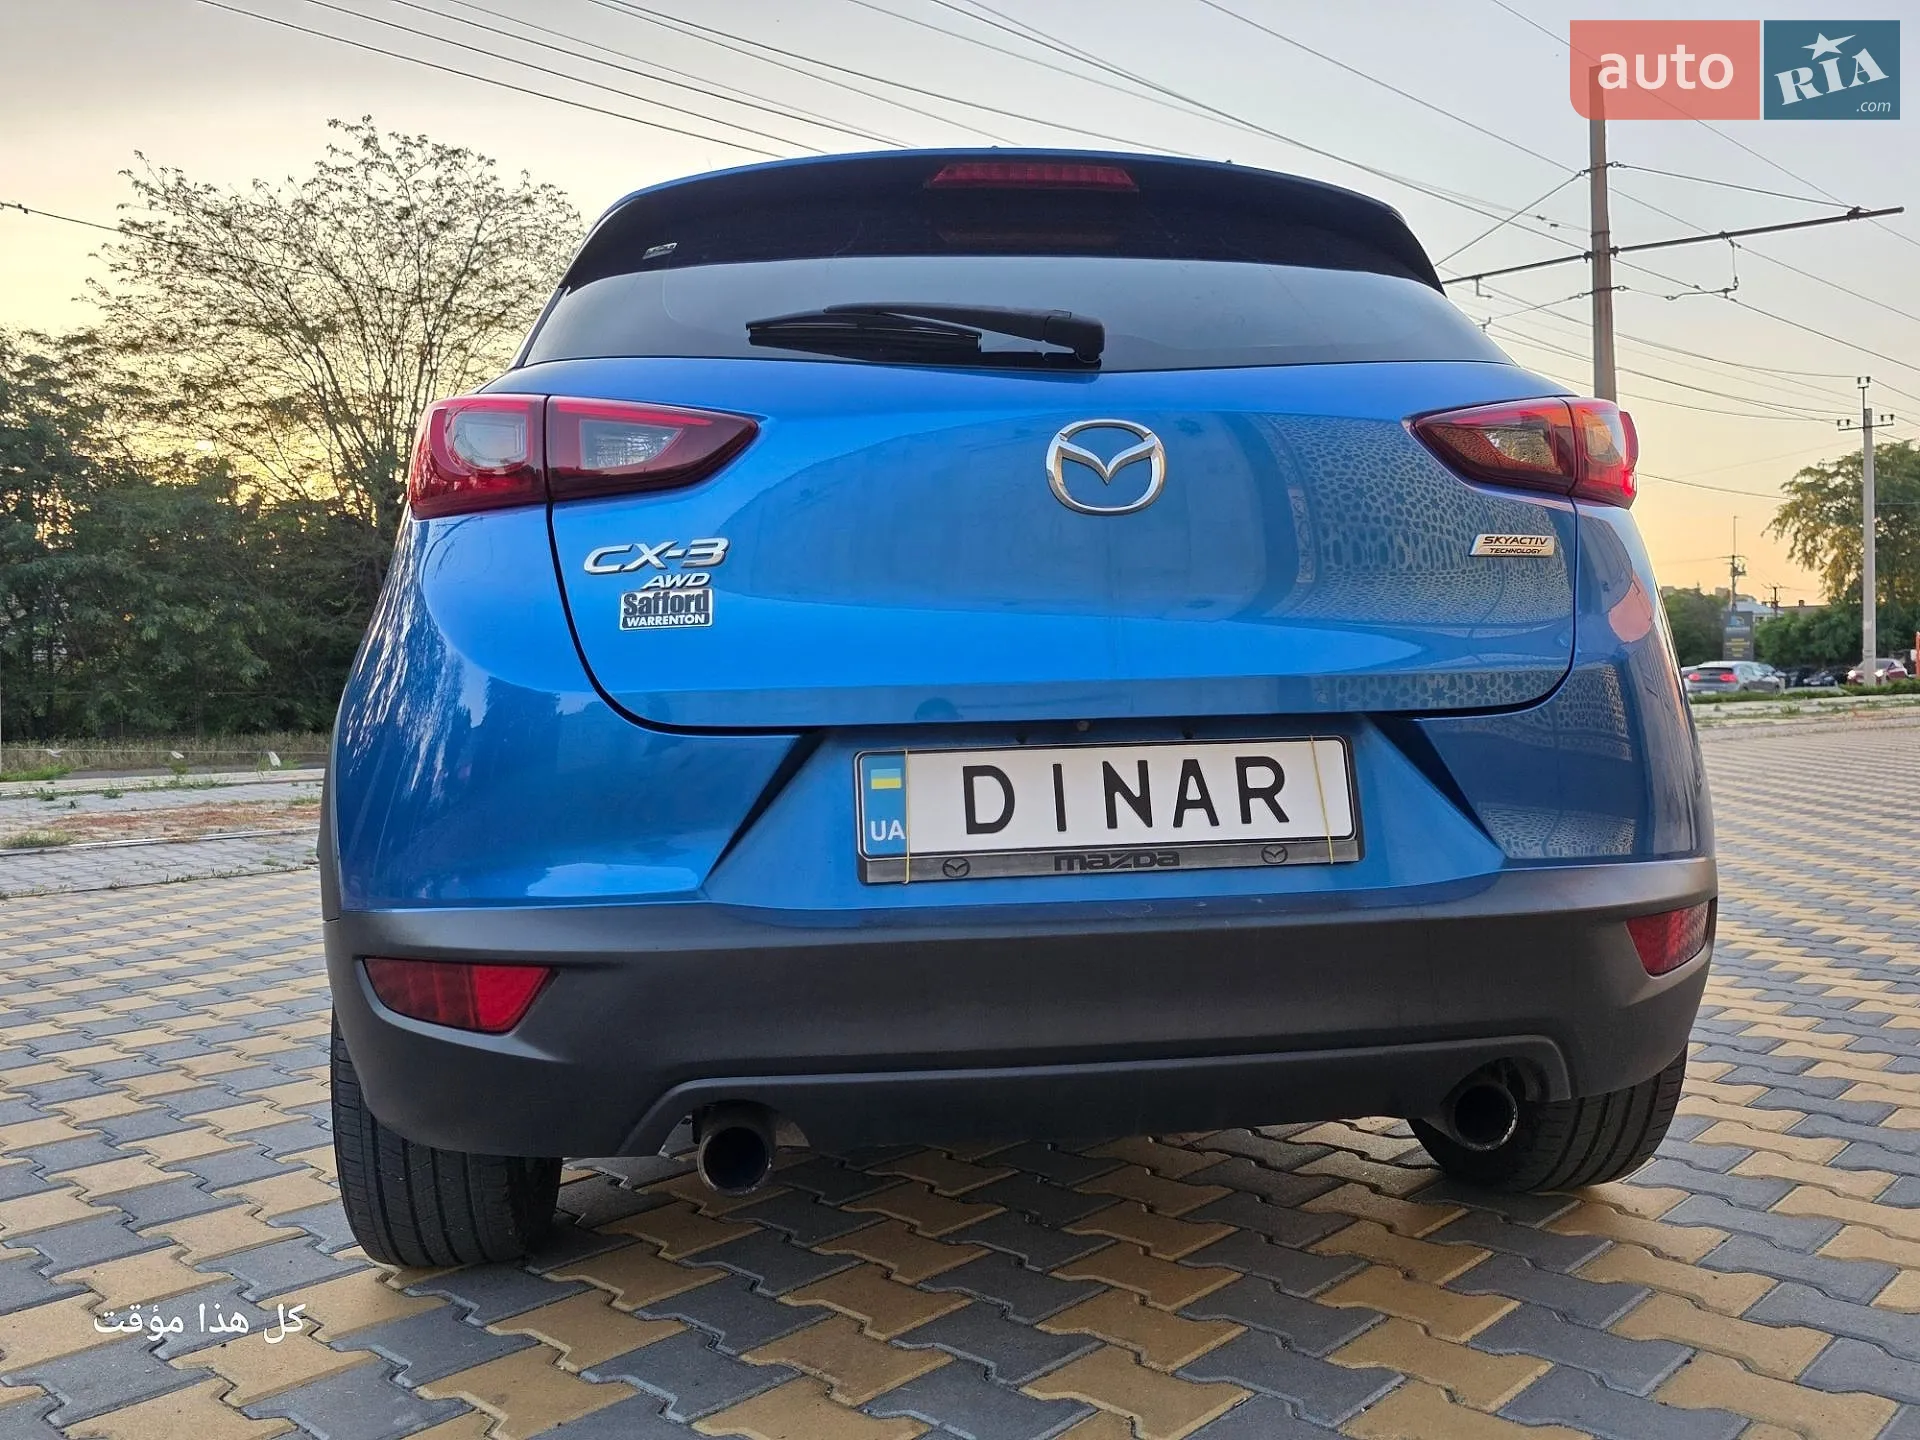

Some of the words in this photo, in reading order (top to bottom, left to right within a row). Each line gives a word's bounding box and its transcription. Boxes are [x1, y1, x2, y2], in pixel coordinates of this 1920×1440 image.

[1483, 536, 1548, 545] SKYACTIV
[584, 537, 729, 574] CX-3
[640, 572, 711, 590] AWD
[624, 589, 709, 616] Safford
[626, 614, 705, 627] WARRENTON
[962, 756, 1290, 835] DINAR
[871, 819, 906, 841] UA
[1054, 850, 1180, 871] mazda
